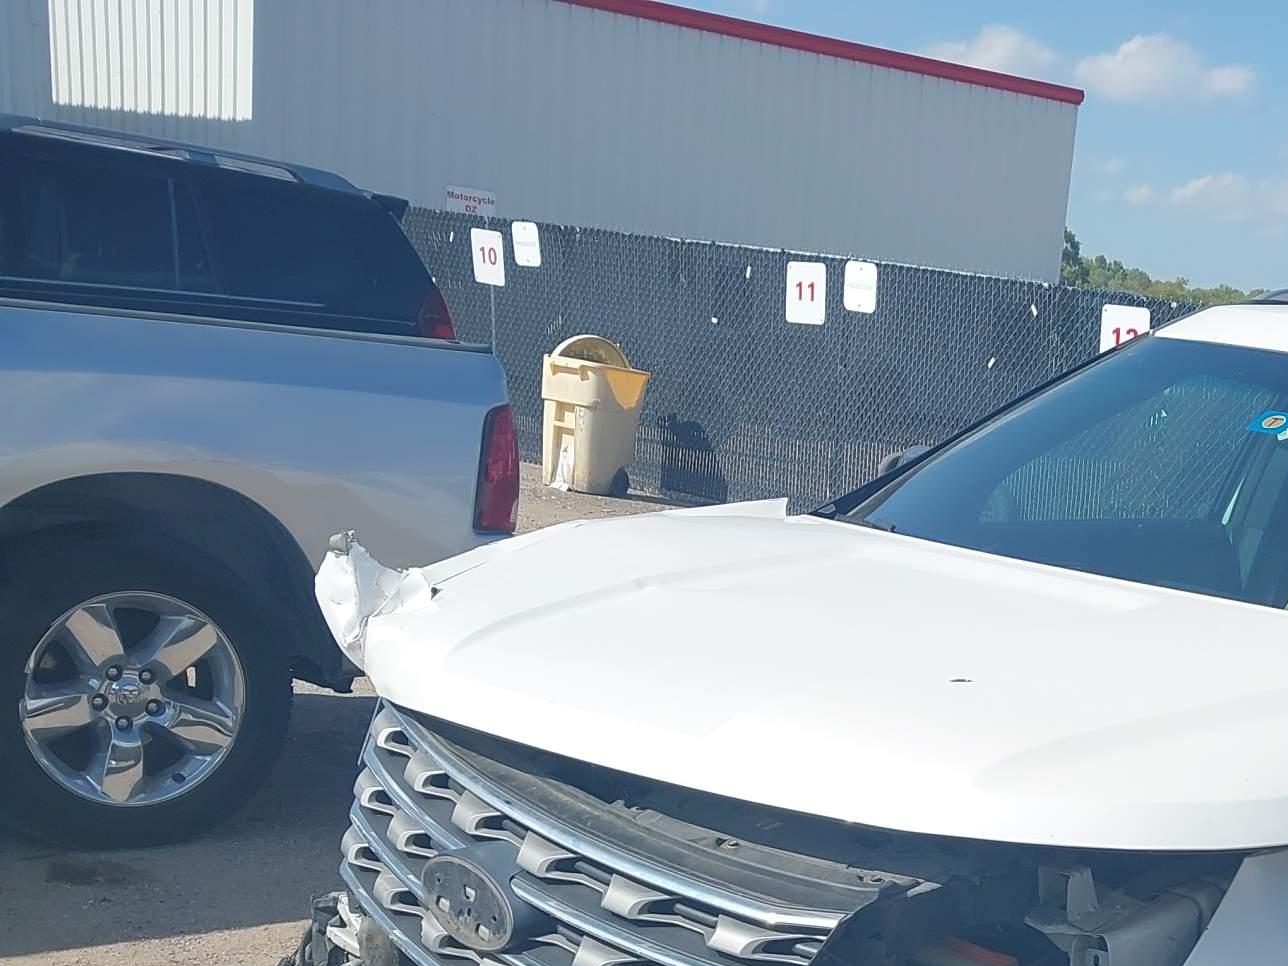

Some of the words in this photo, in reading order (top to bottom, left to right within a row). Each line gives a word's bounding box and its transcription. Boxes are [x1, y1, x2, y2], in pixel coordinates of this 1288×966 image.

[447, 190, 495, 206] Motorcycle
[480, 246, 497, 266] 10
[796, 281, 814, 302] 11
